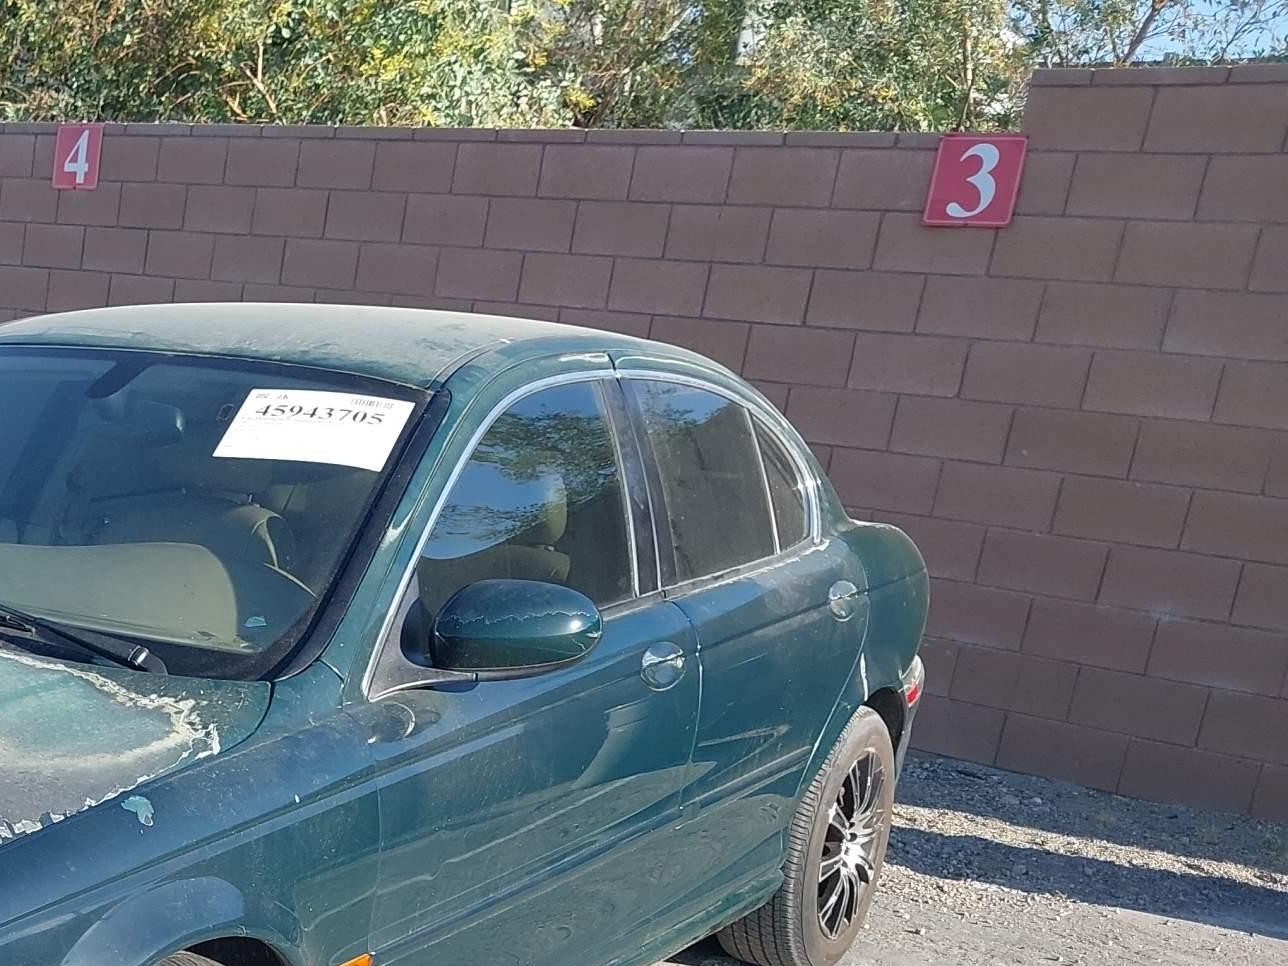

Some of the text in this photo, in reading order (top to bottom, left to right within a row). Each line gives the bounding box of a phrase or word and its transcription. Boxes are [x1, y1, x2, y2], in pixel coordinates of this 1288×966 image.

[64, 128, 89, 184] 4
[945, 142, 1001, 218] 3
[255, 403, 385, 425] 45943705
